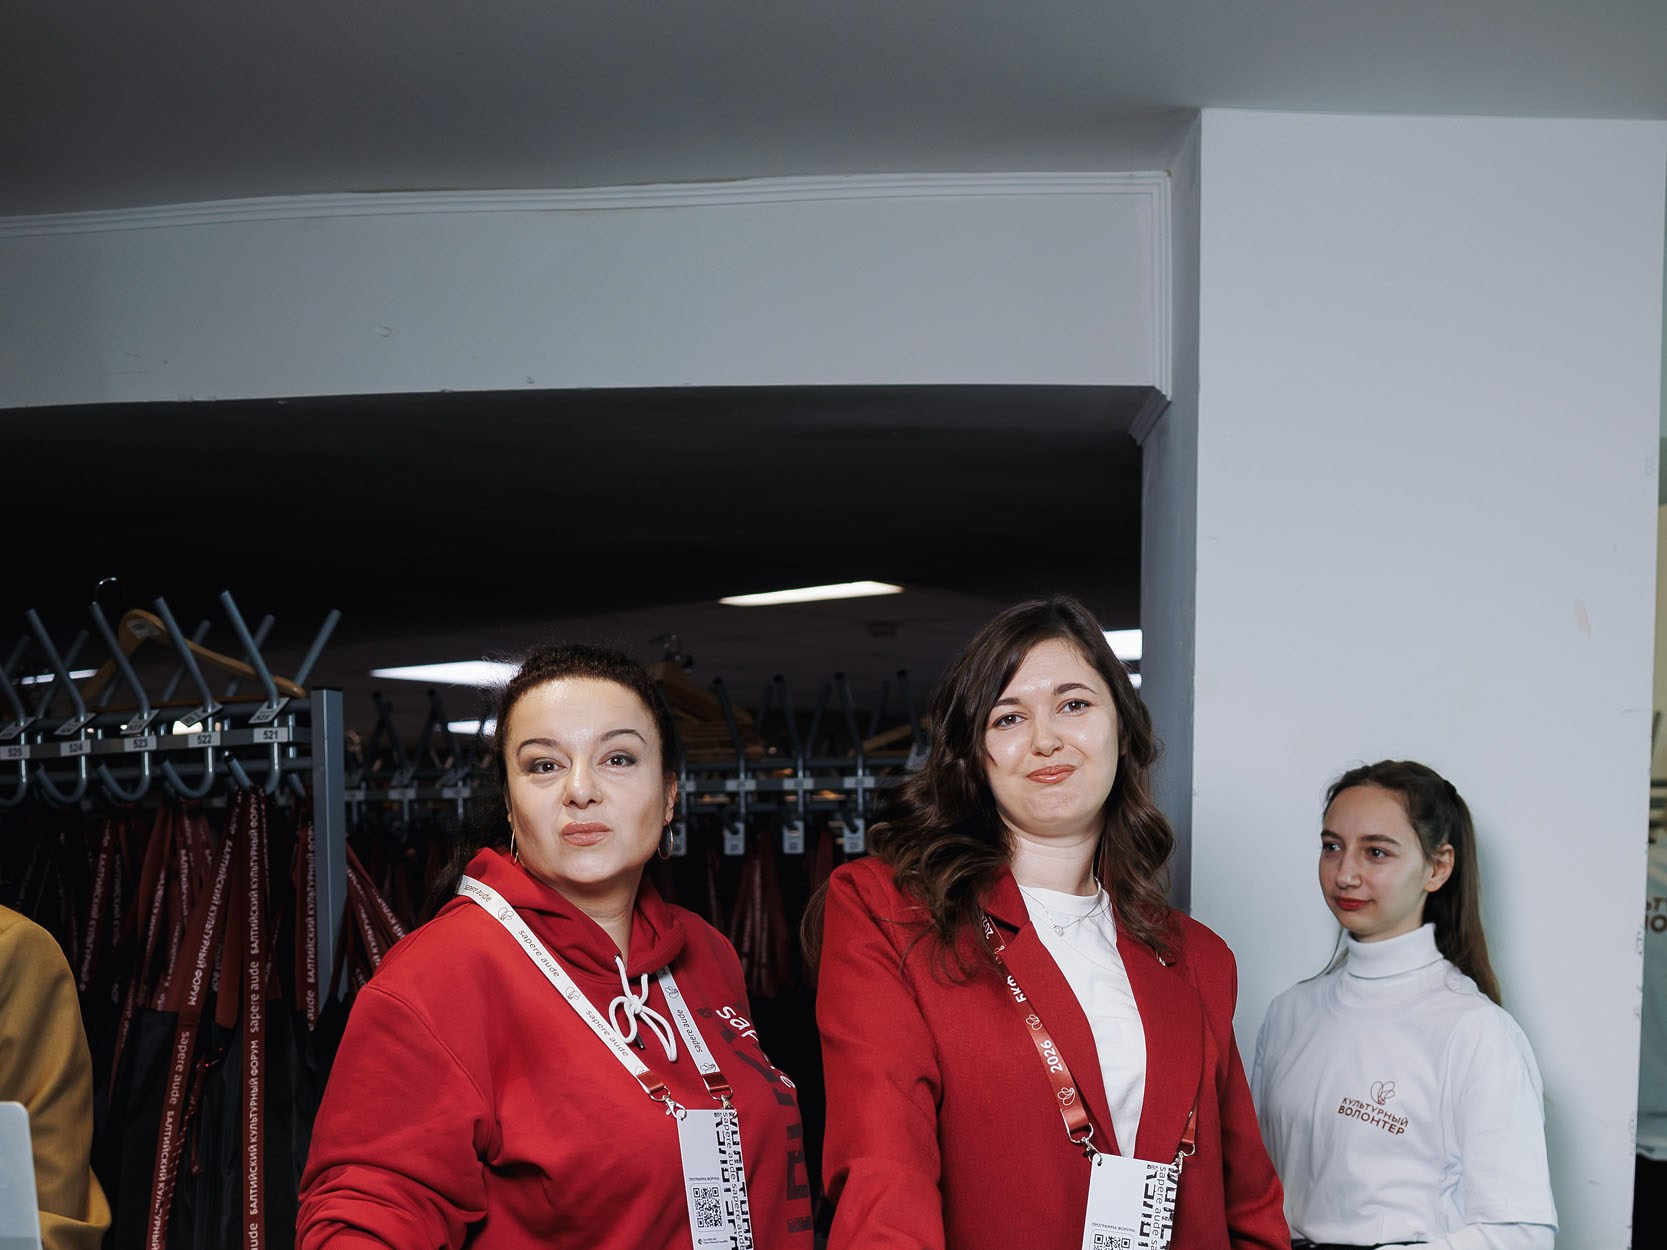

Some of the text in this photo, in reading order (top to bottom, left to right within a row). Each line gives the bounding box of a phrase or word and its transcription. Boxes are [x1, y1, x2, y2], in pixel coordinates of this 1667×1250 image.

[132, 739, 149, 749] 523
[197, 734, 212, 744] 522
[263, 730, 278, 740] 521
[196, 904, 219, 969] КУЛЬТУРНЫЙ
[249, 890, 259, 955] БАЛТИЙСКИЙ
[518, 928, 560, 978] sapere aude
[187, 969, 203, 1006] ФОРУМ
[249, 961, 261, 1033] sapere aude
[586, 1009, 629, 1058] sapere aude
[676, 1009, 703, 1053] sapere aude
[167, 1031, 191, 1105] sapere aude
[1040, 1039, 1064, 1074] 2026
[248, 1040, 259, 1215] БАЛТИЙСКИЙ КУЛЬТУРНЫЙ ФОРУМ
[723, 1112, 732, 1149] sapere
[1338, 1105, 1405, 1136] ВОЛОНТЕР
[1342, 1097, 1409, 1128] КУЛЬТУРНЫЙ
[157, 1110, 175, 1181] БАЛТИЙСКИЙ
[728, 1152, 736, 1180] aude
[731, 1183, 742, 1220] sapere
[1155, 1166, 1167, 1205] sapere
[737, 1224, 746, 1250] aude
[1152, 1207, 1162, 1236] aude
